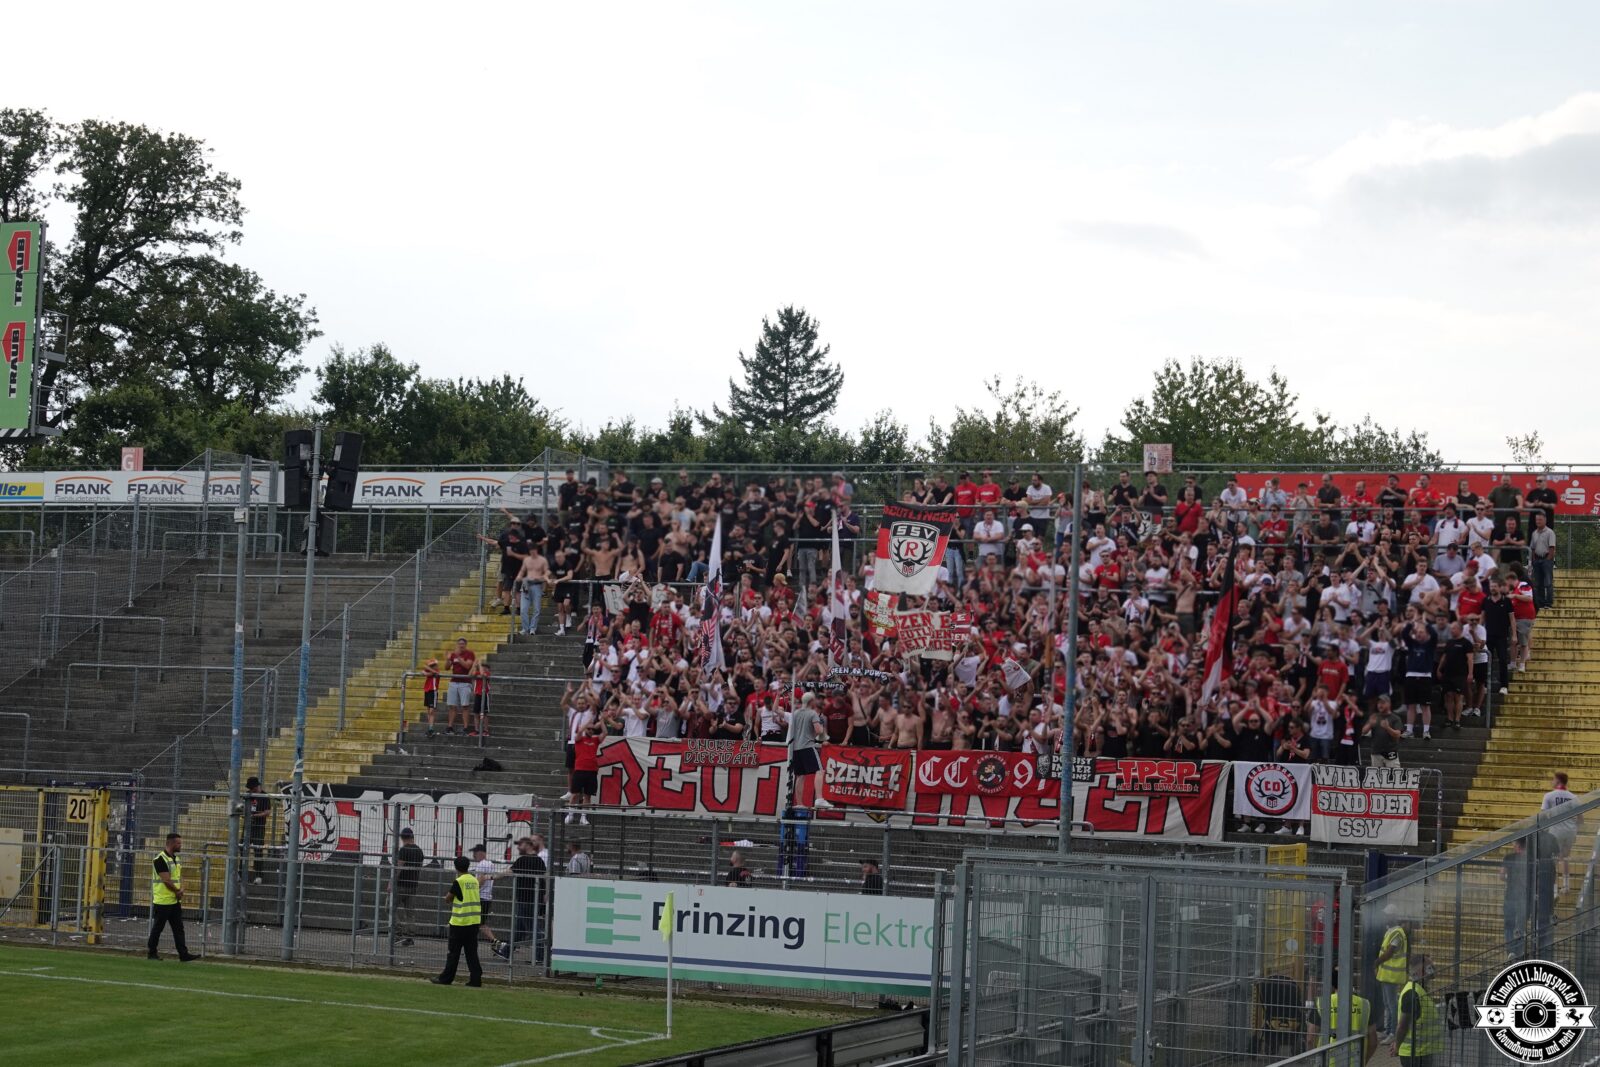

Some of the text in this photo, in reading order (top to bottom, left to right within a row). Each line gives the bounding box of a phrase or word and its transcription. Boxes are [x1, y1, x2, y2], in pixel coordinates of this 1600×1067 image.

[14, 238, 25, 306] TRAUB
[8, 329, 20, 398] TRAUB
[122, 454, 135, 471] G
[55, 483, 111, 495] FRANK
[127, 483, 185, 495] FRANK
[203, 484, 260, 495] FRAK
[361, 485, 423, 497] FRANK
[439, 485, 503, 497] FRANK
[883, 505, 957, 523] REUTLINGEN
[896, 525, 935, 539] SSV
[904, 542, 919, 557] R
[825, 757, 902, 792] SZENE E
[1117, 760, 1197, 785] TPSP
[1313, 765, 1420, 790] WIR ALLE
[829, 785, 894, 799] REUTLINGEN
[1264, 781, 1281, 792] CD
[70, 798, 87, 819] 20
[1318, 791, 1412, 815] SIND DER
[1338, 818, 1382, 838] SSV
[652, 901, 806, 950] Prinzing
